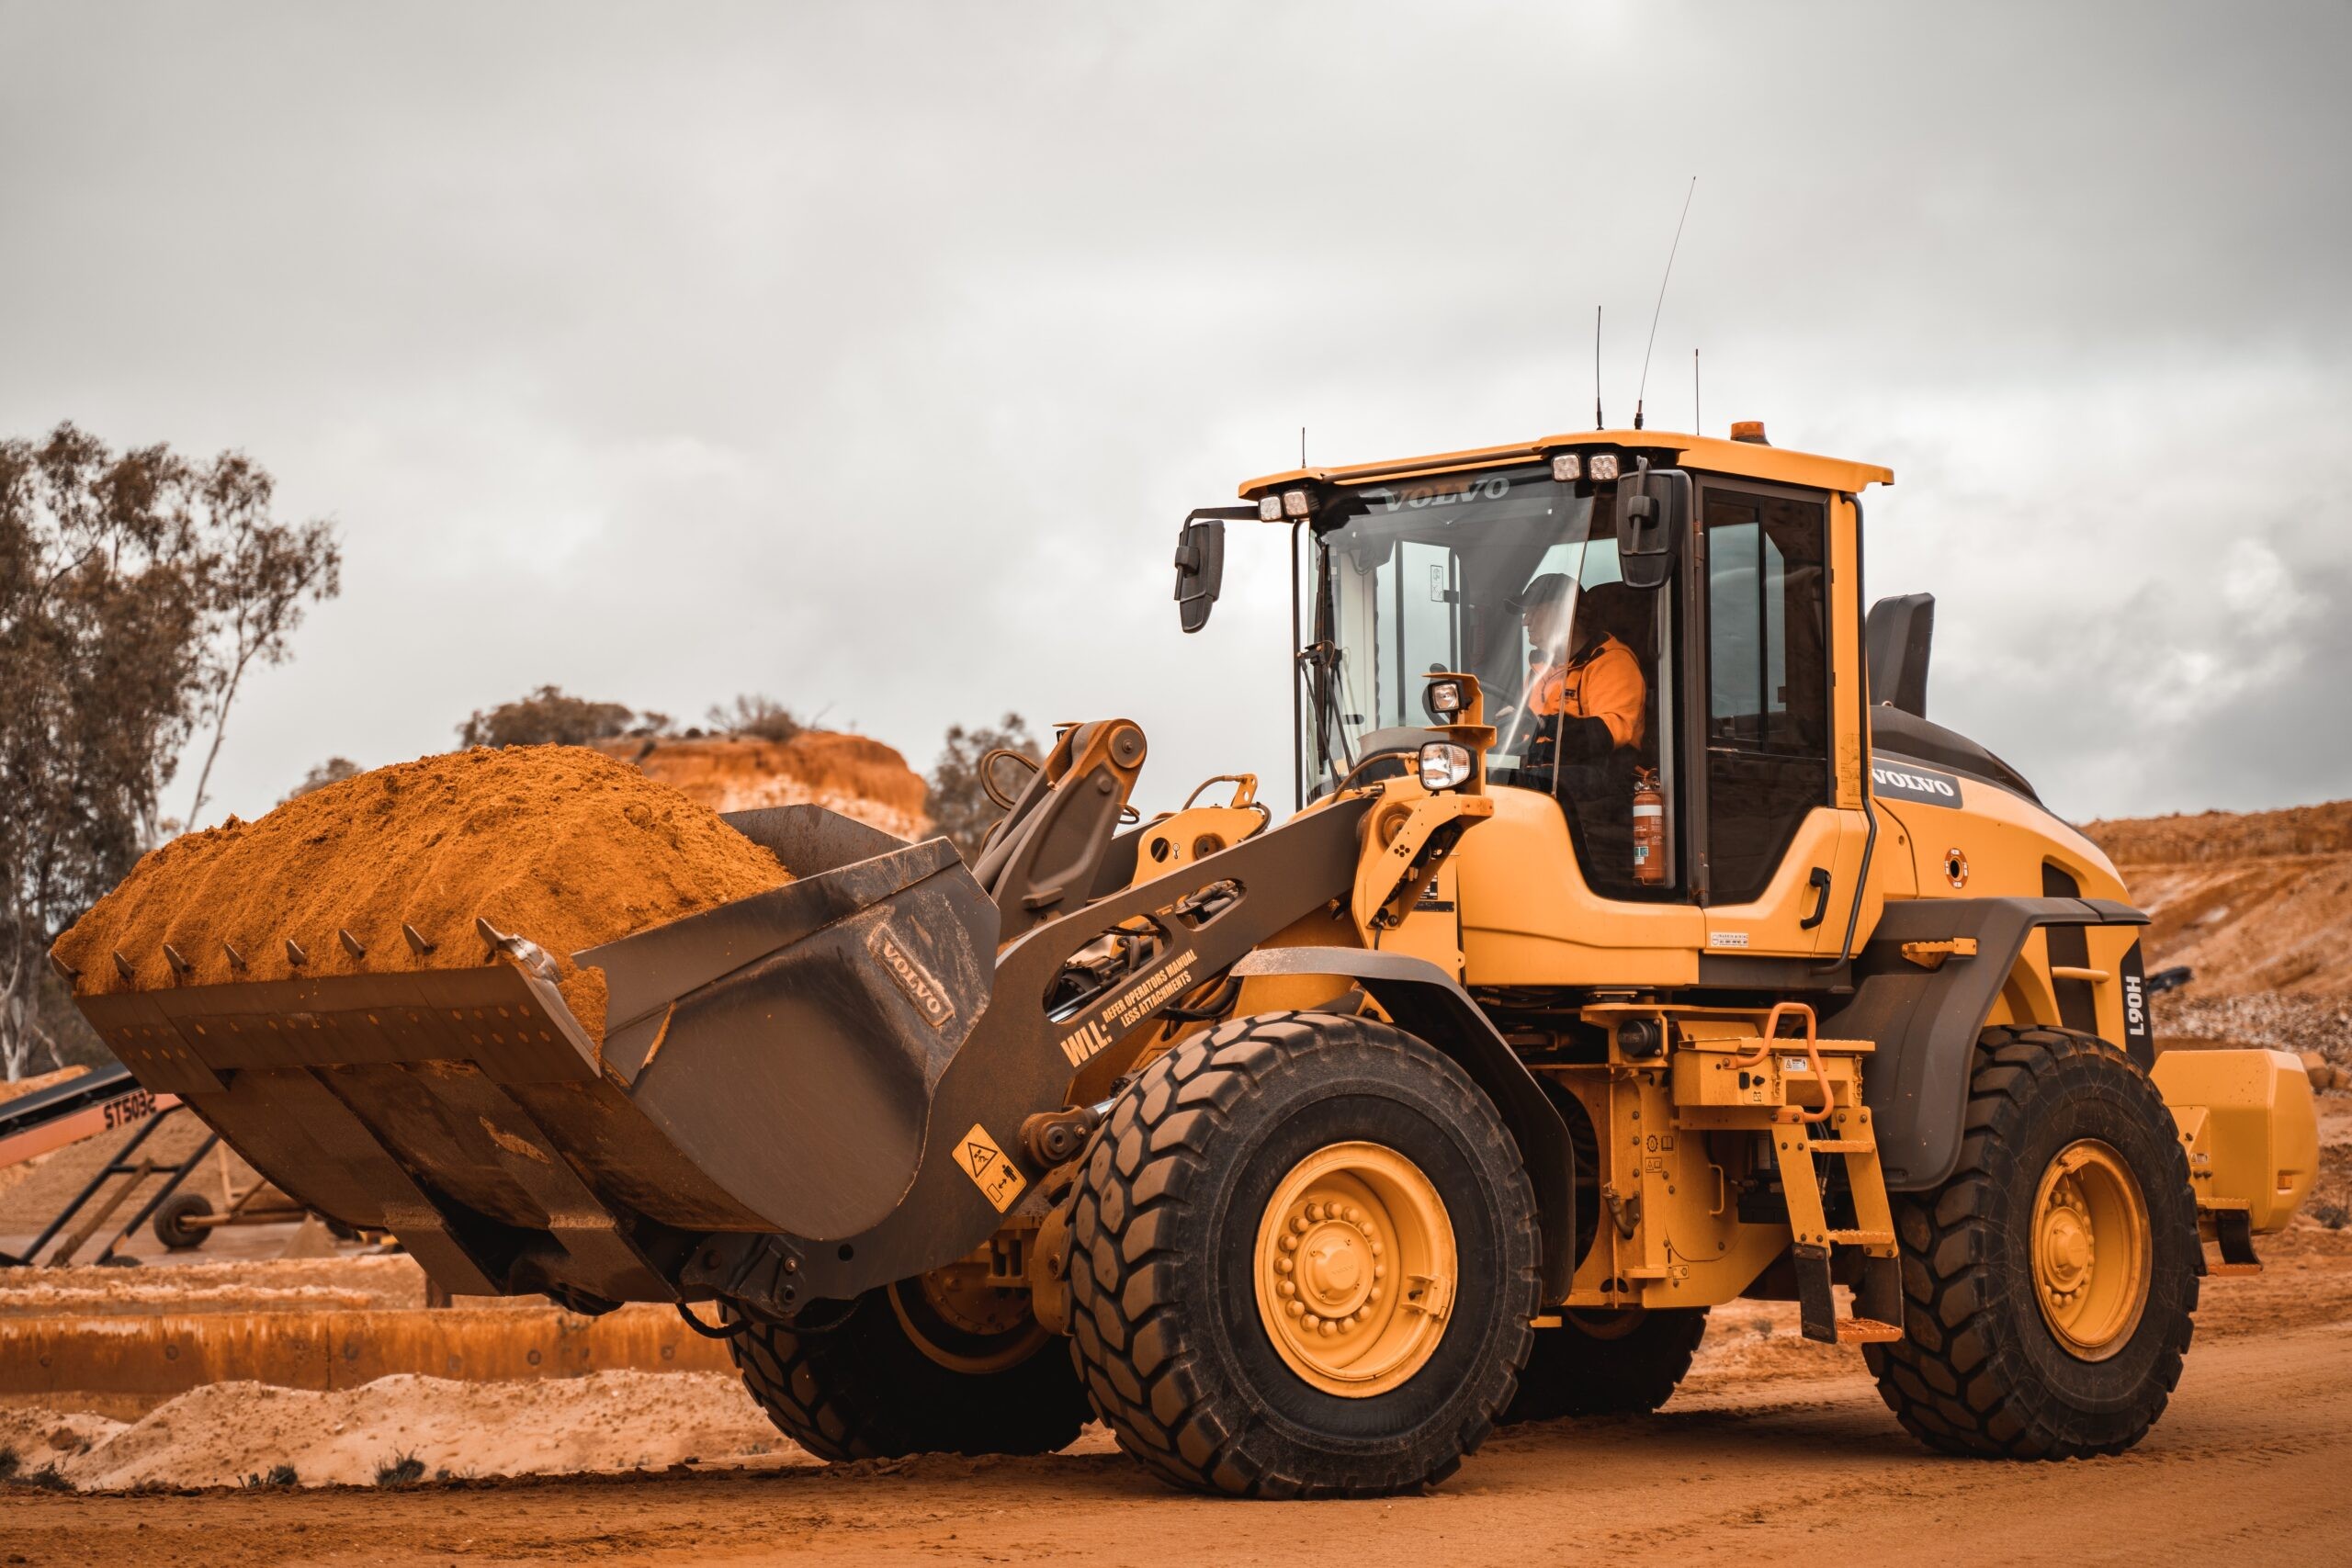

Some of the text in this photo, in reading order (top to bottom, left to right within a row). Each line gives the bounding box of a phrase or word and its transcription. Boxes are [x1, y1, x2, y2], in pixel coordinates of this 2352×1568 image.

[1382, 477, 1510, 512] VOLVO
[1871, 769, 1954, 796] VOLVO
[883, 939, 940, 1013] VOLVO
[1102, 949, 1198, 1023] REFER OPERATORS MANUAL
[1120, 970, 1193, 1028] LESS ATTACHMENTS
[2125, 976, 2144, 1035] L90H
[1060, 1021, 1113, 1068] WLL:
